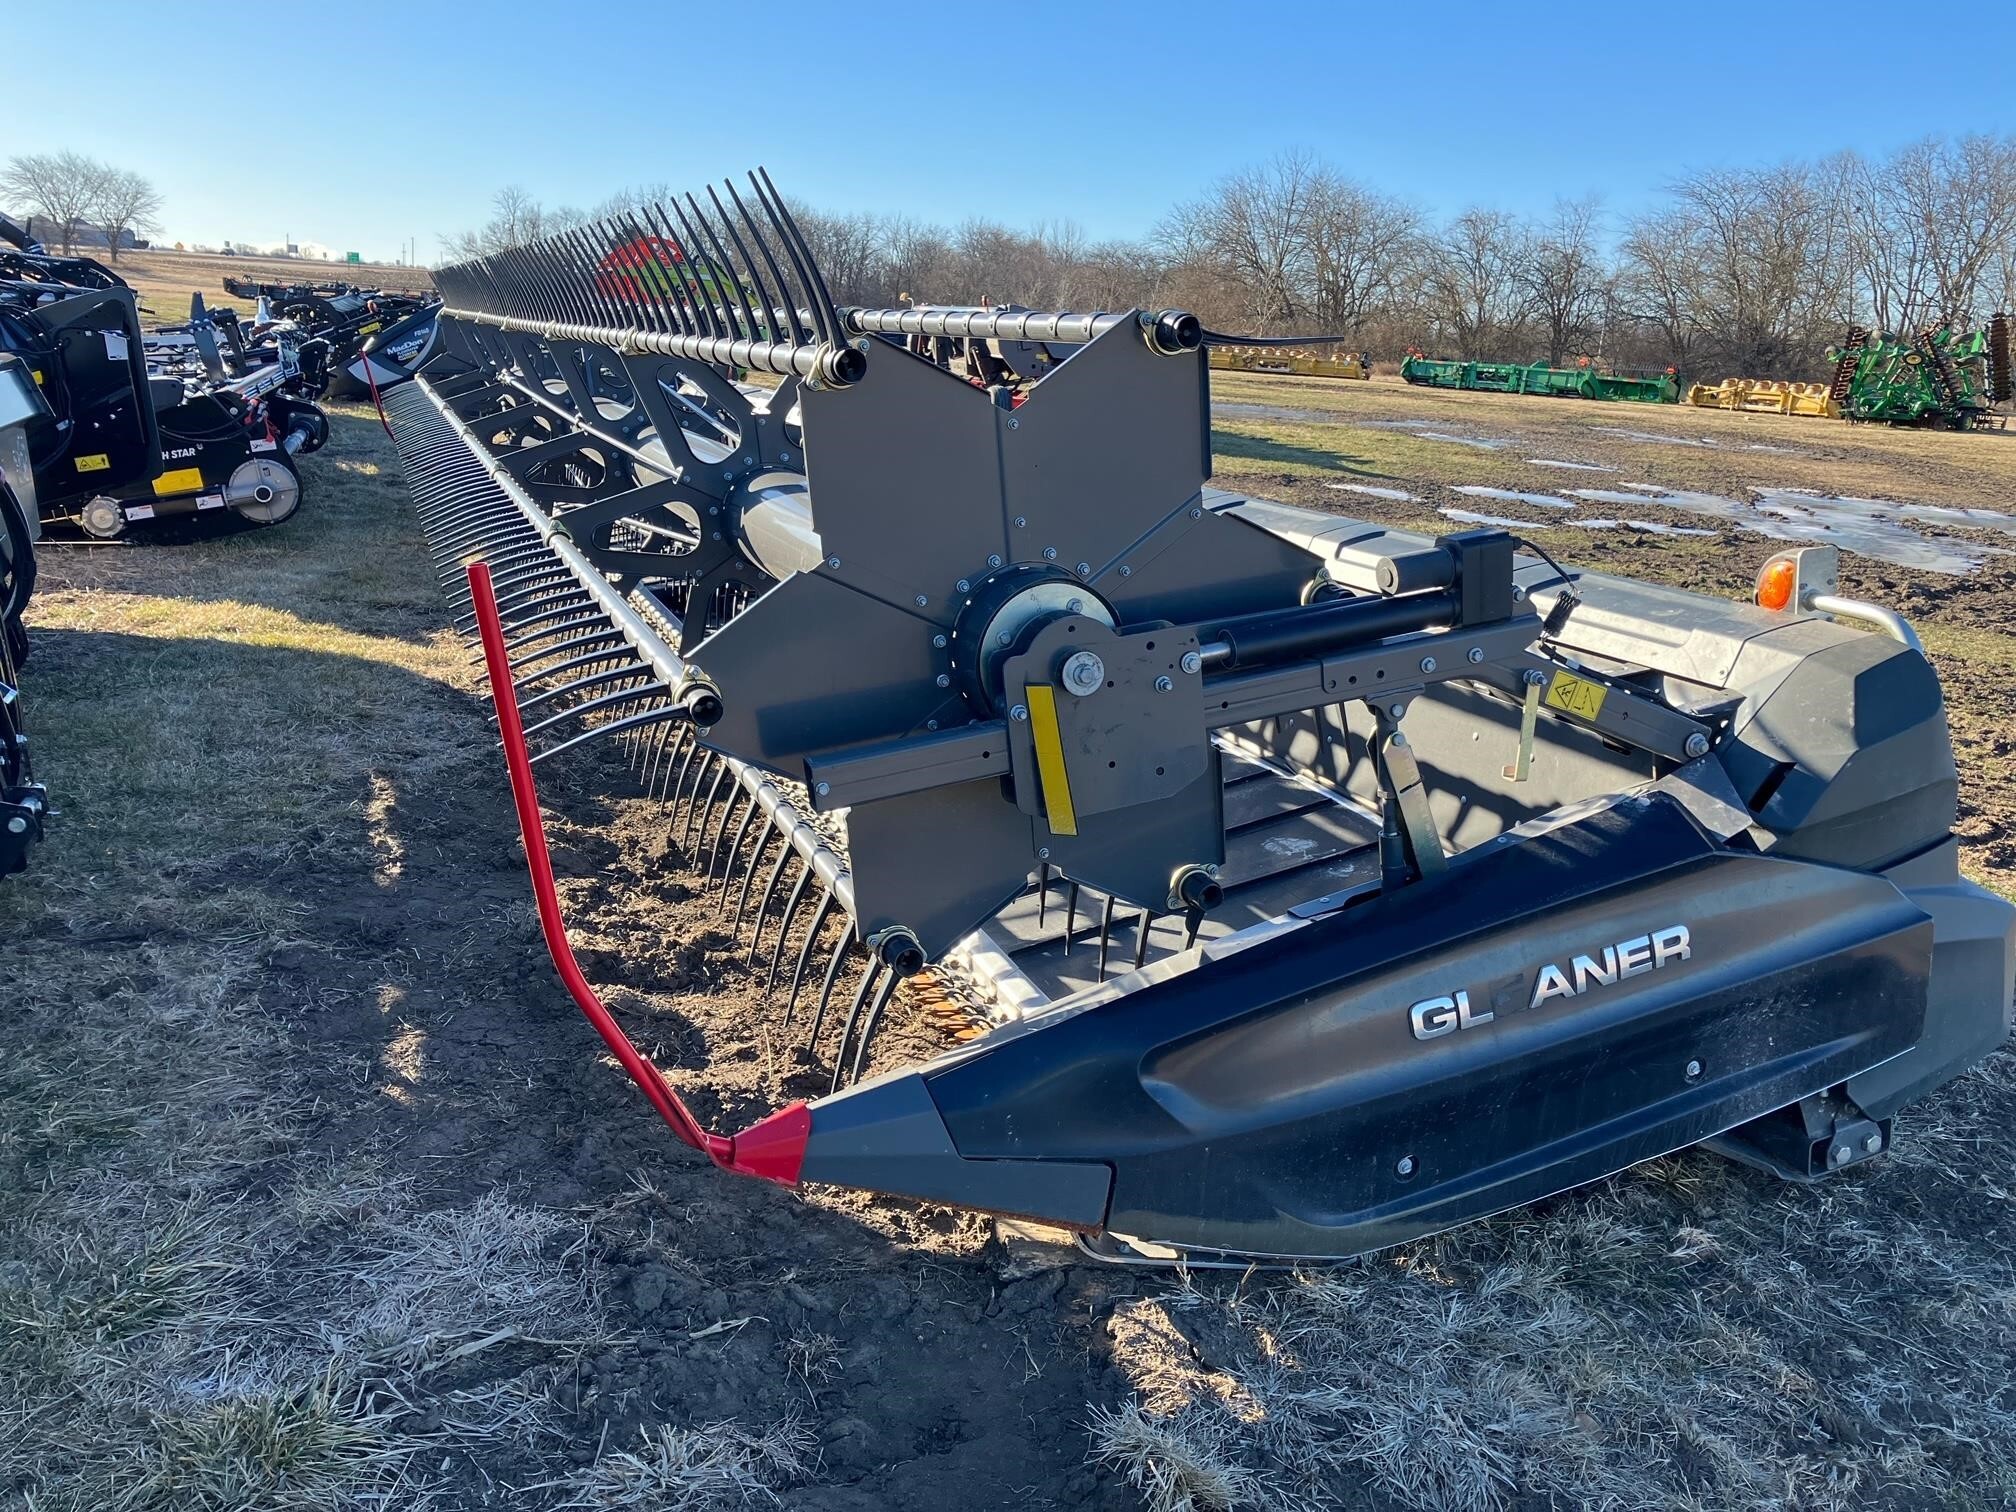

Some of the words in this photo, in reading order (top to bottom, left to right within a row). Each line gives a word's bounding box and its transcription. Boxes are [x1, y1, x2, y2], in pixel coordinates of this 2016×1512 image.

[386, 339, 424, 355] MacDon
[171, 447, 196, 459] STAR
[1408, 924, 1691, 1041] GLANER
